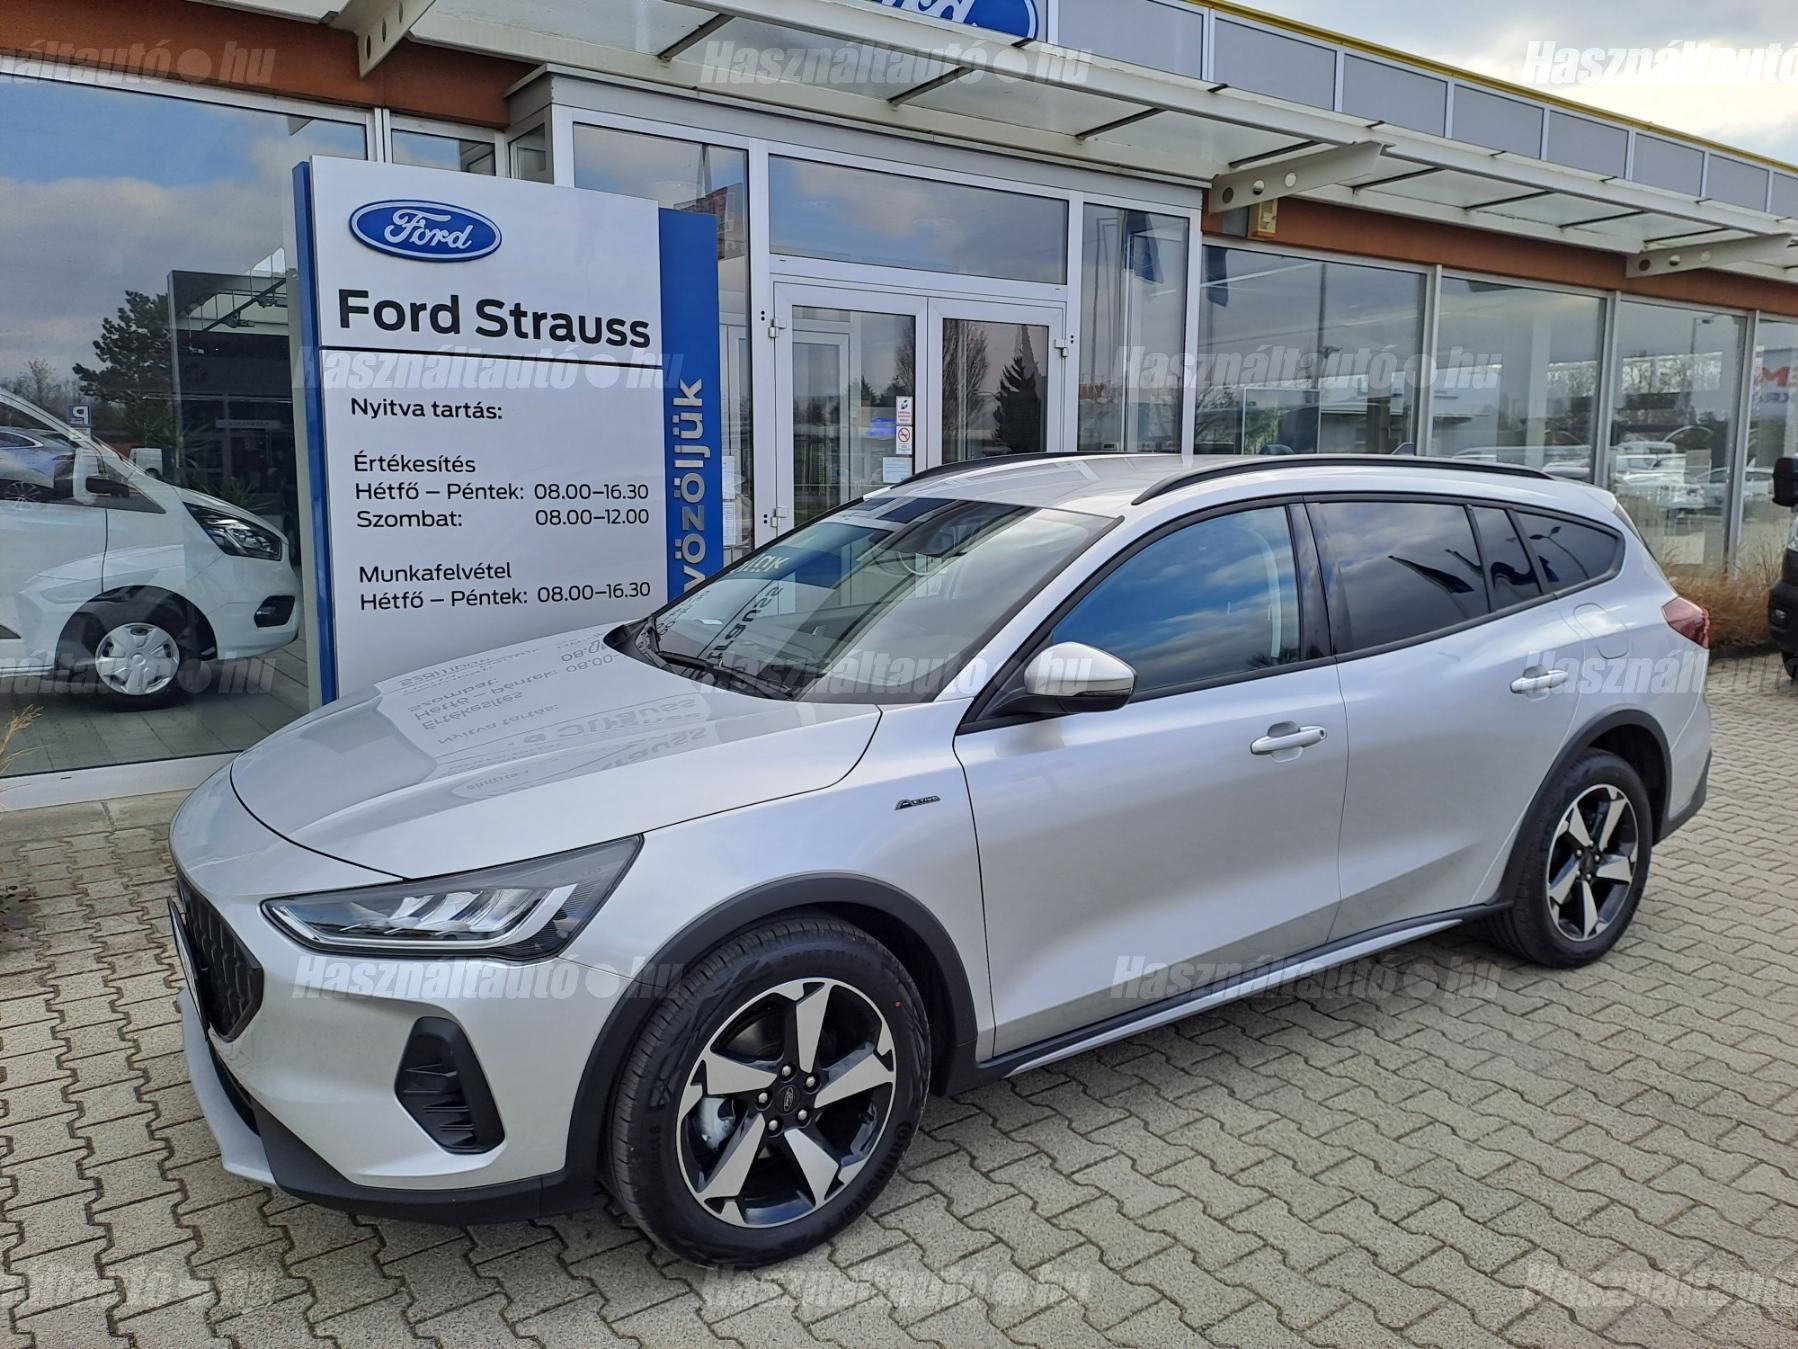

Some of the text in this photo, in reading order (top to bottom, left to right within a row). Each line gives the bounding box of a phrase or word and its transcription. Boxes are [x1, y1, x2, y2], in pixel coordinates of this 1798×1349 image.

[384, 209, 474, 250] Ford
[338, 288, 651, 348] Ford Strauss
[351, 398, 503, 420] Nyitva tartás:
[354, 450, 476, 473] Értékesítés
[355, 481, 420, 500] Hétfő
[447, 482, 524, 500] Péntek:
[534, 484, 649, 500] 08.00–16.30
[356, 508, 649, 528] Szombat: 08.00–12.00
[359, 562, 512, 583] Munkafelvétel
[360, 591, 424, 610] Hétfő
[451, 588, 528, 607] Péntek:
[537, 581, 651, 603] 08.00–16.30
